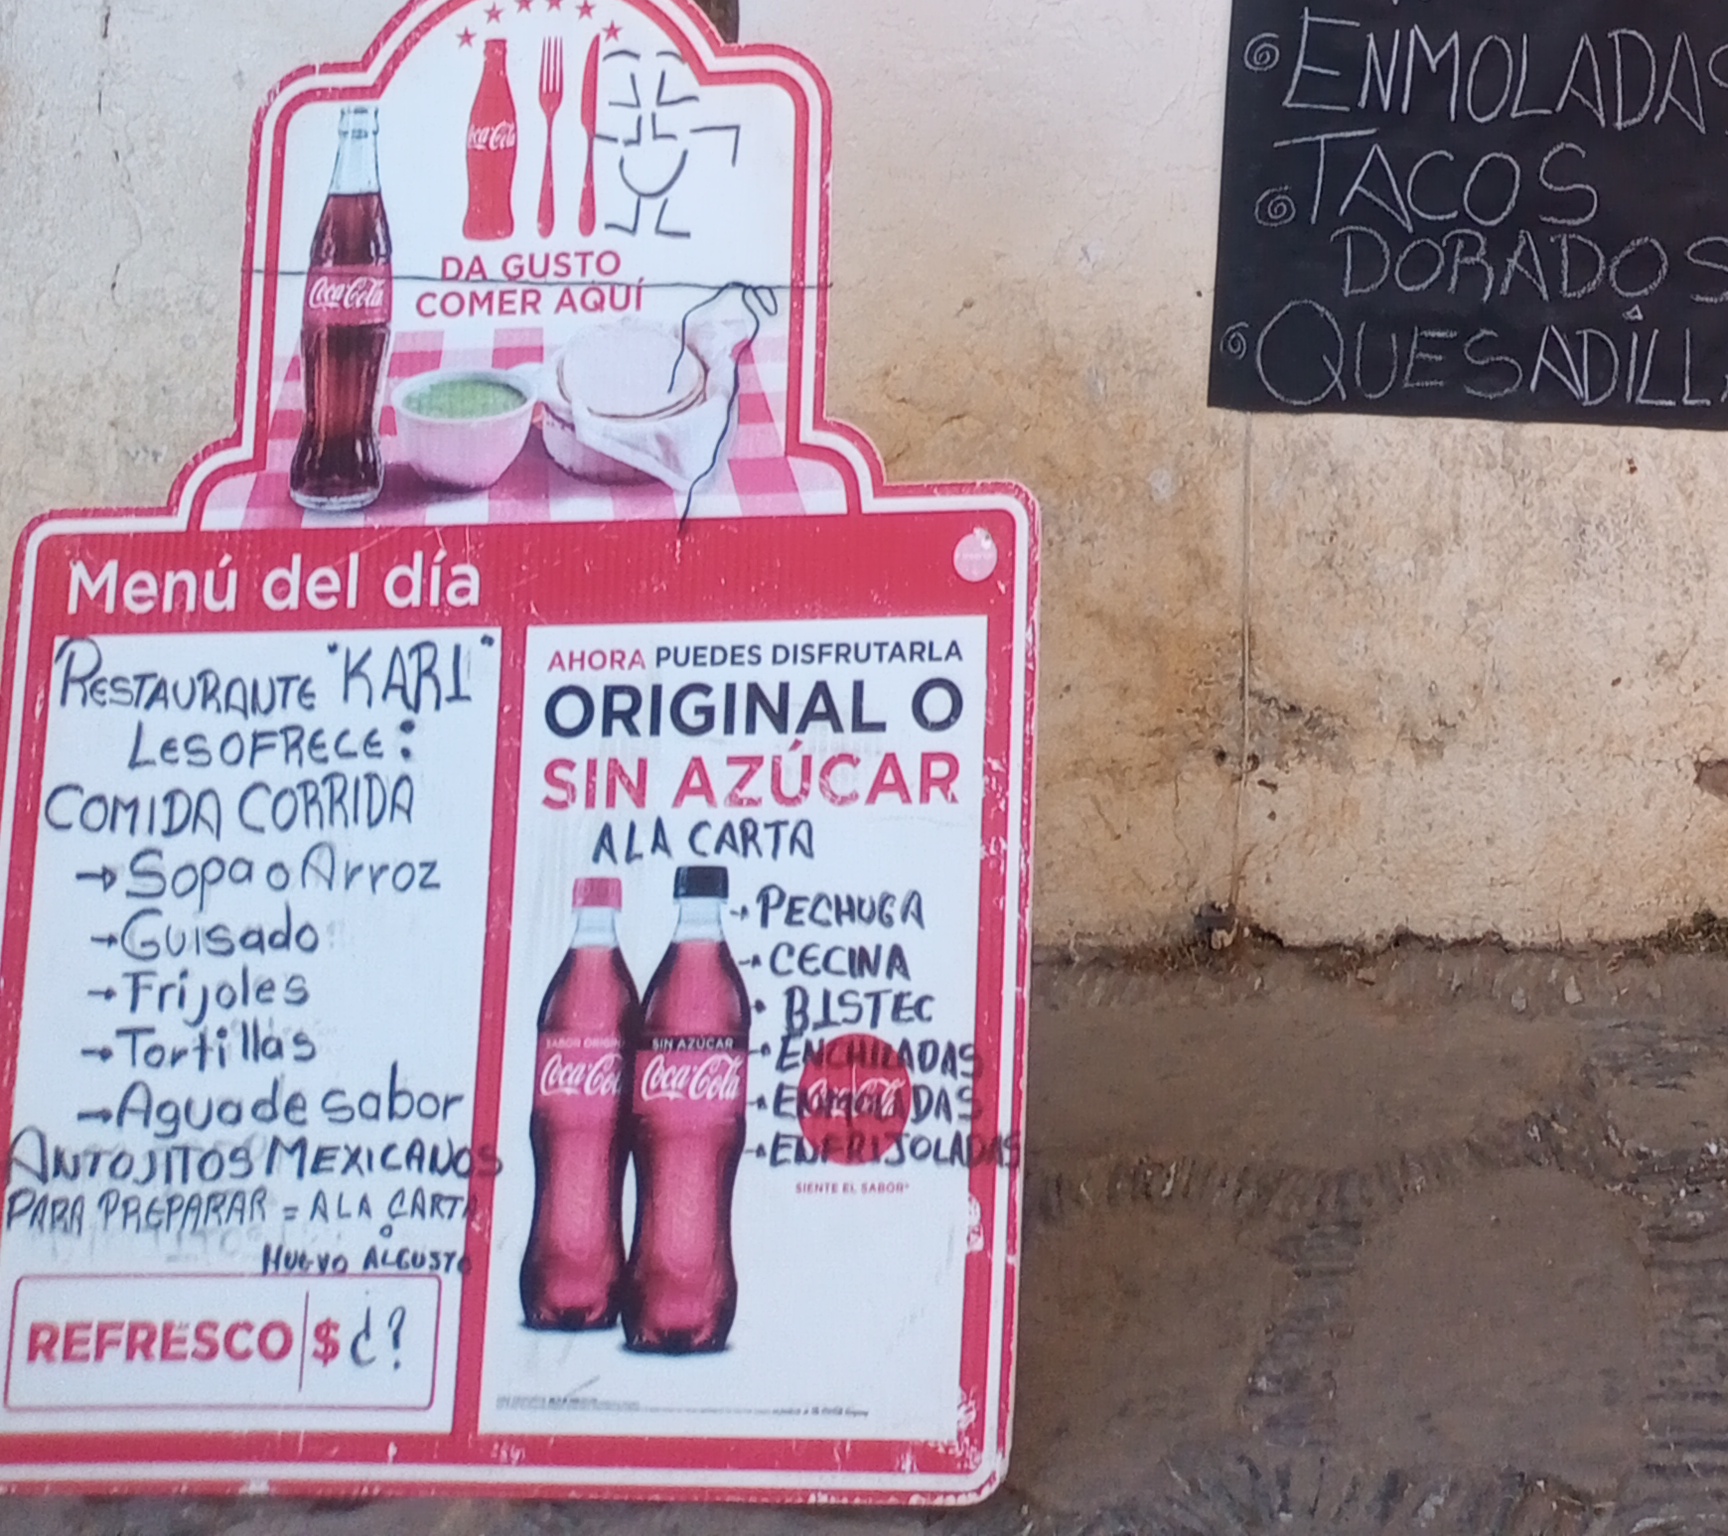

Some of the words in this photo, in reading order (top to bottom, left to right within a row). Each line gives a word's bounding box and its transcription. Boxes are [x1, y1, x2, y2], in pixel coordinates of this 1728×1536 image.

[1273, 128, 1600, 234] TACOS
[308, 275, 385, 310] Coca-Cola
[440, 254, 488, 283] DA
[501, 249, 622, 280] GUSTO
[415, 287, 542, 319] COMER
[553, 275, 645, 315] AQUÍ
[66, 553, 238, 616] Menú
[261, 551, 360, 612] del
[383, 548, 481, 608] día
[546, 649, 647, 672] AHORA
[655, 643, 763, 669] PUEDES
[770, 640, 964, 668] DISFRUTARLA
[544, 679, 888, 739] ORIGINAL
[910, 676, 965, 733] O
[540, 756, 650, 813] SIN
[670, 738, 962, 811] AZÚCAR
[44, 783, 222, 841] COMIDA
[238, 772, 414, 835] CORRIDA
[687, 817, 815, 862] CARTA
[125, 846, 254, 912] Sopa
[265, 860, 290, 892] o
[300, 841, 442, 895] Arroz
[120, 900, 320, 962] Guisado
[755, 883, 928, 931] PECHUGA
[768, 941, 912, 984] CECINA
[122, 965, 311, 1028] Frijoles
[783, 984, 936, 1039] BISTEC
[115, 1016, 317, 1073] Tortillas
[651, 1037, 674, 1050] SIN
[677, 1035, 734, 1050] AZÚCAR
[774, 1030, 985, 1081] ENCHILADAS
[116, 1080, 250, 1139] Agua
[321, 1060, 465, 1124] sabor
[640, 1052, 744, 1103] Coca-Cola
[7, 1125, 254, 1186] ANTOJITOS
[265, 1134, 504, 1180] MEXICANOS
[7, 1186, 85, 1237] PARA
[97, 1184, 268, 1234] PREPARAR
[387, 1185, 479, 1221] CARTA
[795, 1181, 839, 1194] SIENTE
[842, 1181, 857, 1194] EL
[26, 1318, 294, 1365] REFRESCO
